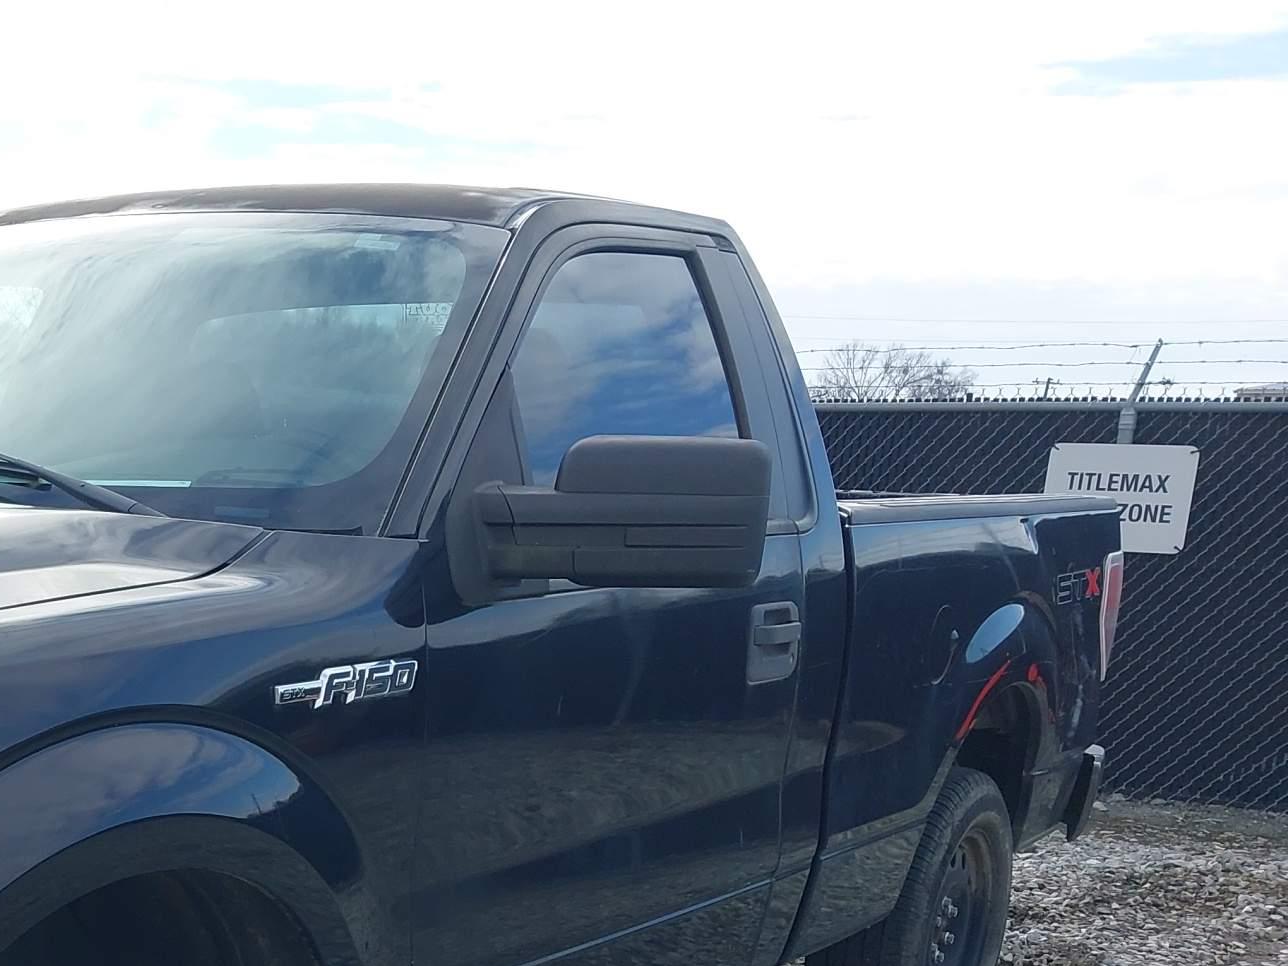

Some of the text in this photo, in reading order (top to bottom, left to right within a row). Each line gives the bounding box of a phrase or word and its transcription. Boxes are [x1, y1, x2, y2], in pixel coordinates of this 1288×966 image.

[1067, 472, 1171, 494] TITLEMAX
[1118, 503, 1173, 524] ZONE
[1056, 567, 1100, 605] STX
[282, 687, 306, 700] STX
